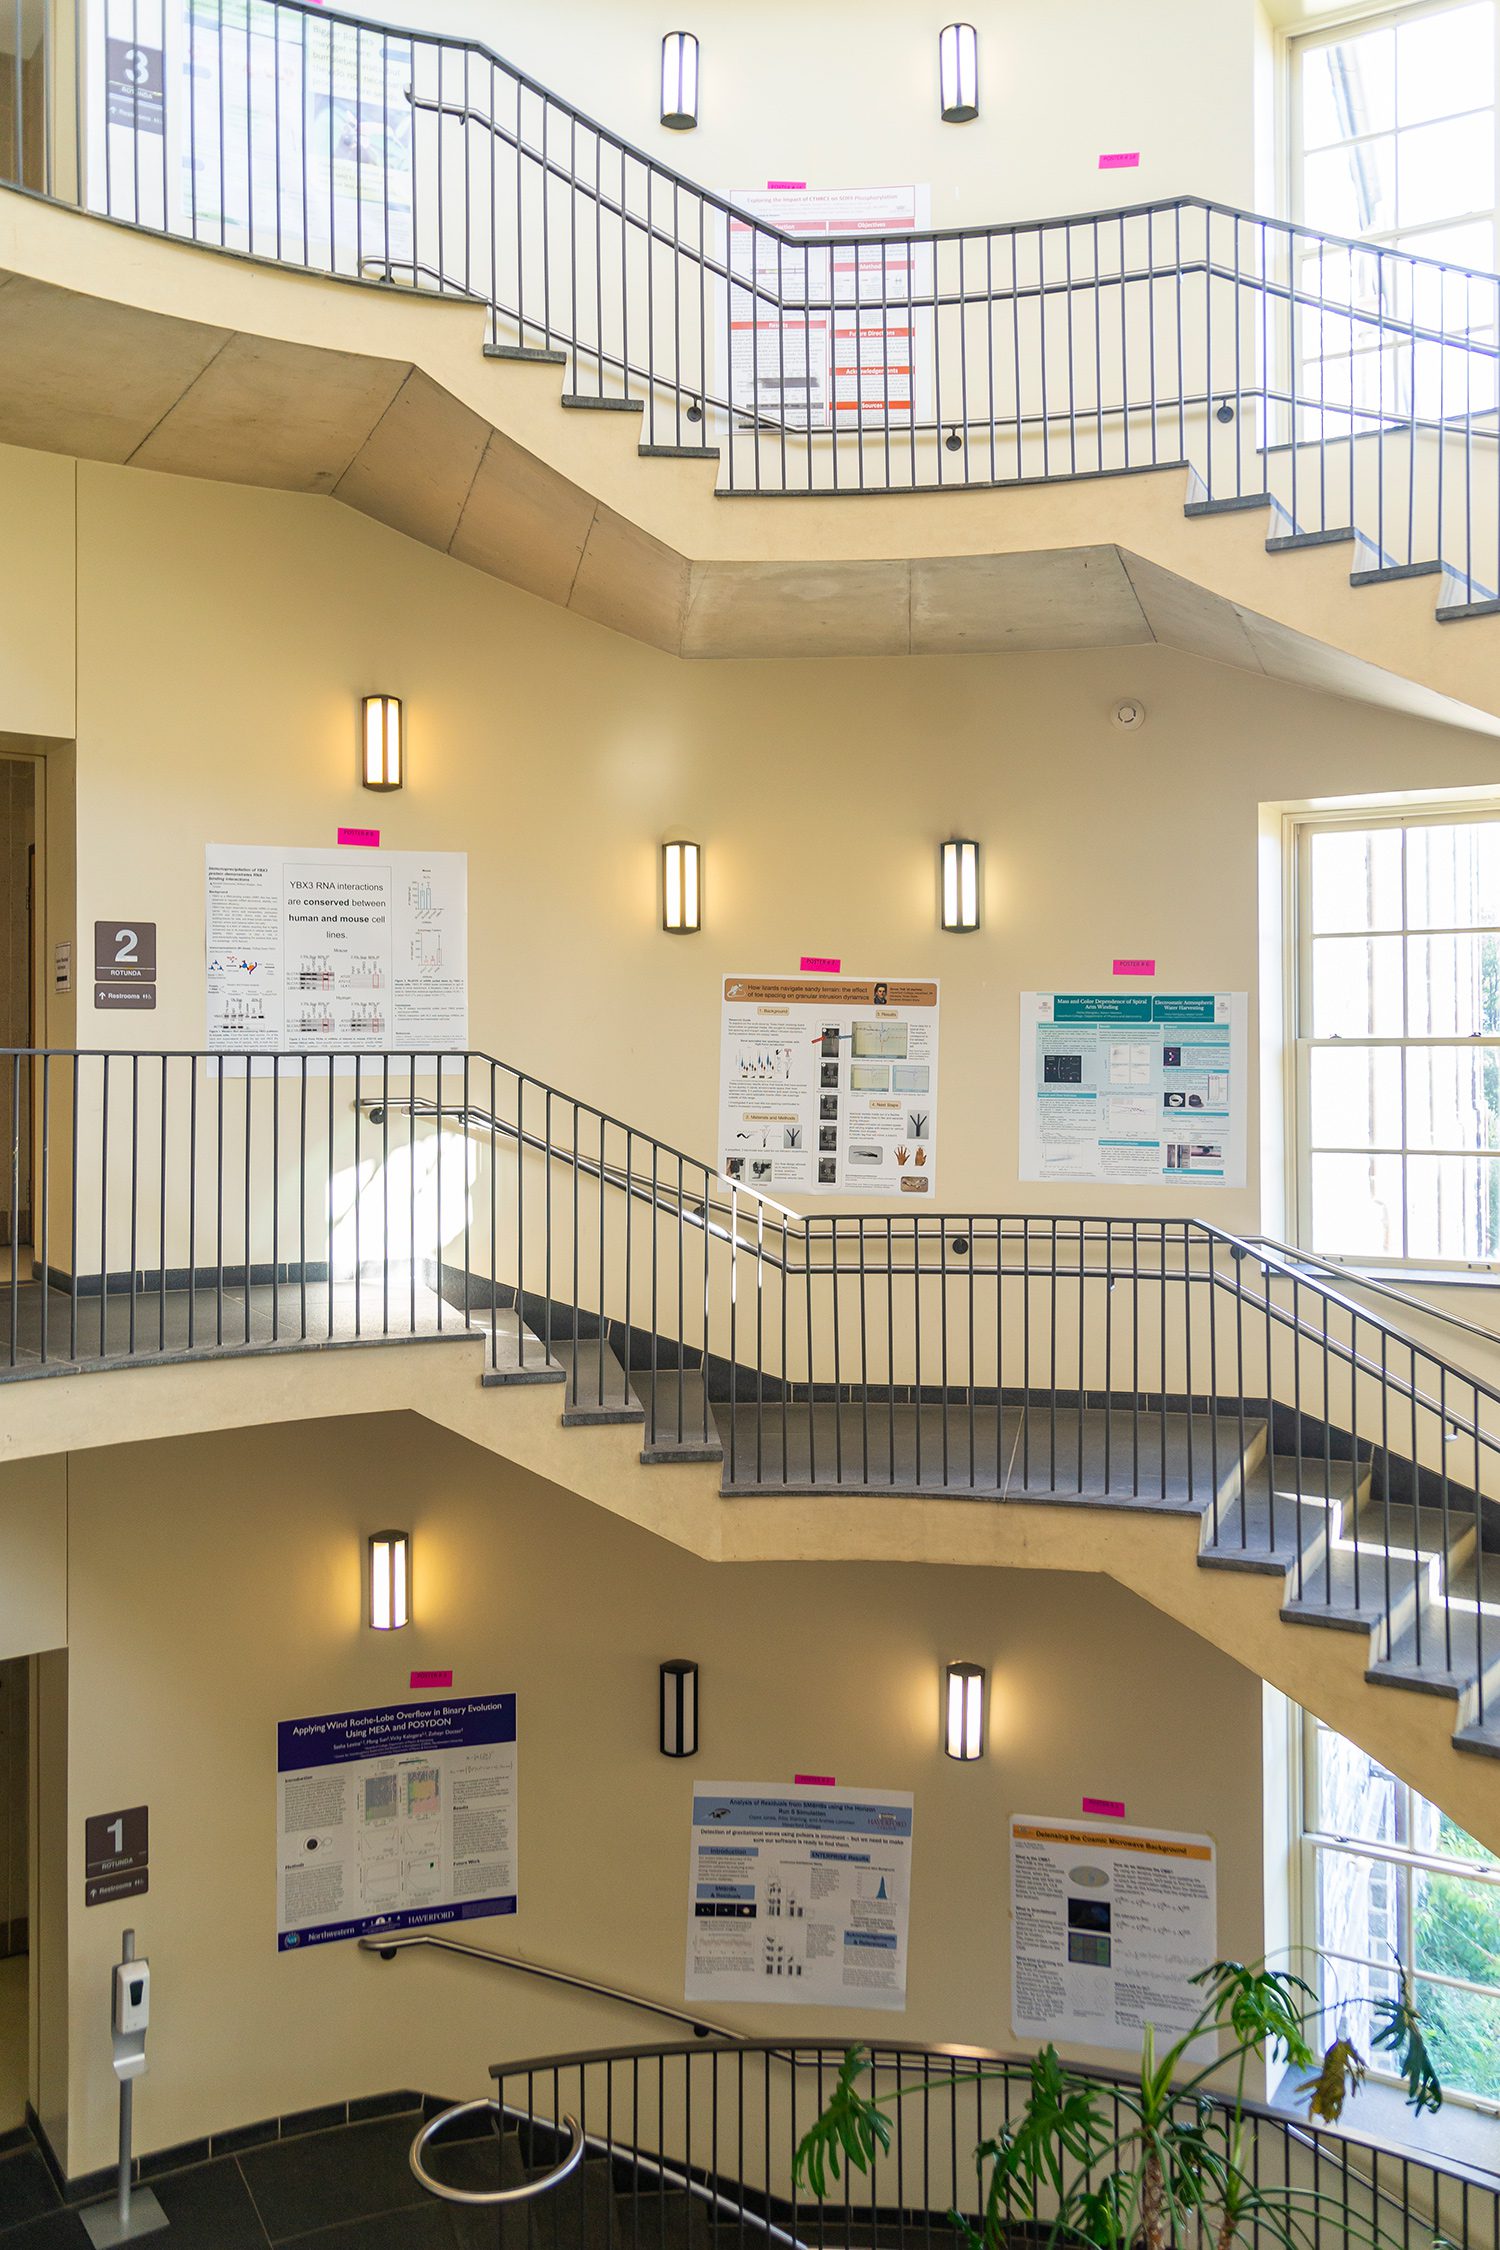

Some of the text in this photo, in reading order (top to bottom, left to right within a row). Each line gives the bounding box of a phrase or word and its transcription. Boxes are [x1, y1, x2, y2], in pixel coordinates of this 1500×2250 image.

[125, 49, 149, 84] 3
[290, 881, 384, 891] YBX3 RNA interactions
[352, 899, 386, 907] between
[289, 914, 319, 922] human
[321, 914, 338, 922] and
[372, 915, 386, 923] cell
[326, 931, 348, 939] lines.
[115, 929, 138, 963] 2
[110, 969, 142, 977] ROTUNDA
[108, 992, 140, 1000] Restrooms
[293, 1702, 502, 1736] Applying Wind Roche-Lobe Overflow in Binary Evolution
[345, 1718, 452, 1738] Using MESA and POSYDON
[285, 1775, 313, 1784] Introduction
[854, 1805, 876, 1813] Horizon
[107, 1818, 123, 1853] 1
[732, 1829, 764, 1837] gravitational
[1108, 1837, 1145, 1848] Microwave
[1145, 1843, 1187, 1854] Background
[811, 1851, 870, 1862] ENTERPRISE Results
[101, 1857, 134, 1871] ROTUNDA
[408, 1911, 455, 1925] HAVERFORD
[308, 1927, 355, 1942] Northwestern
